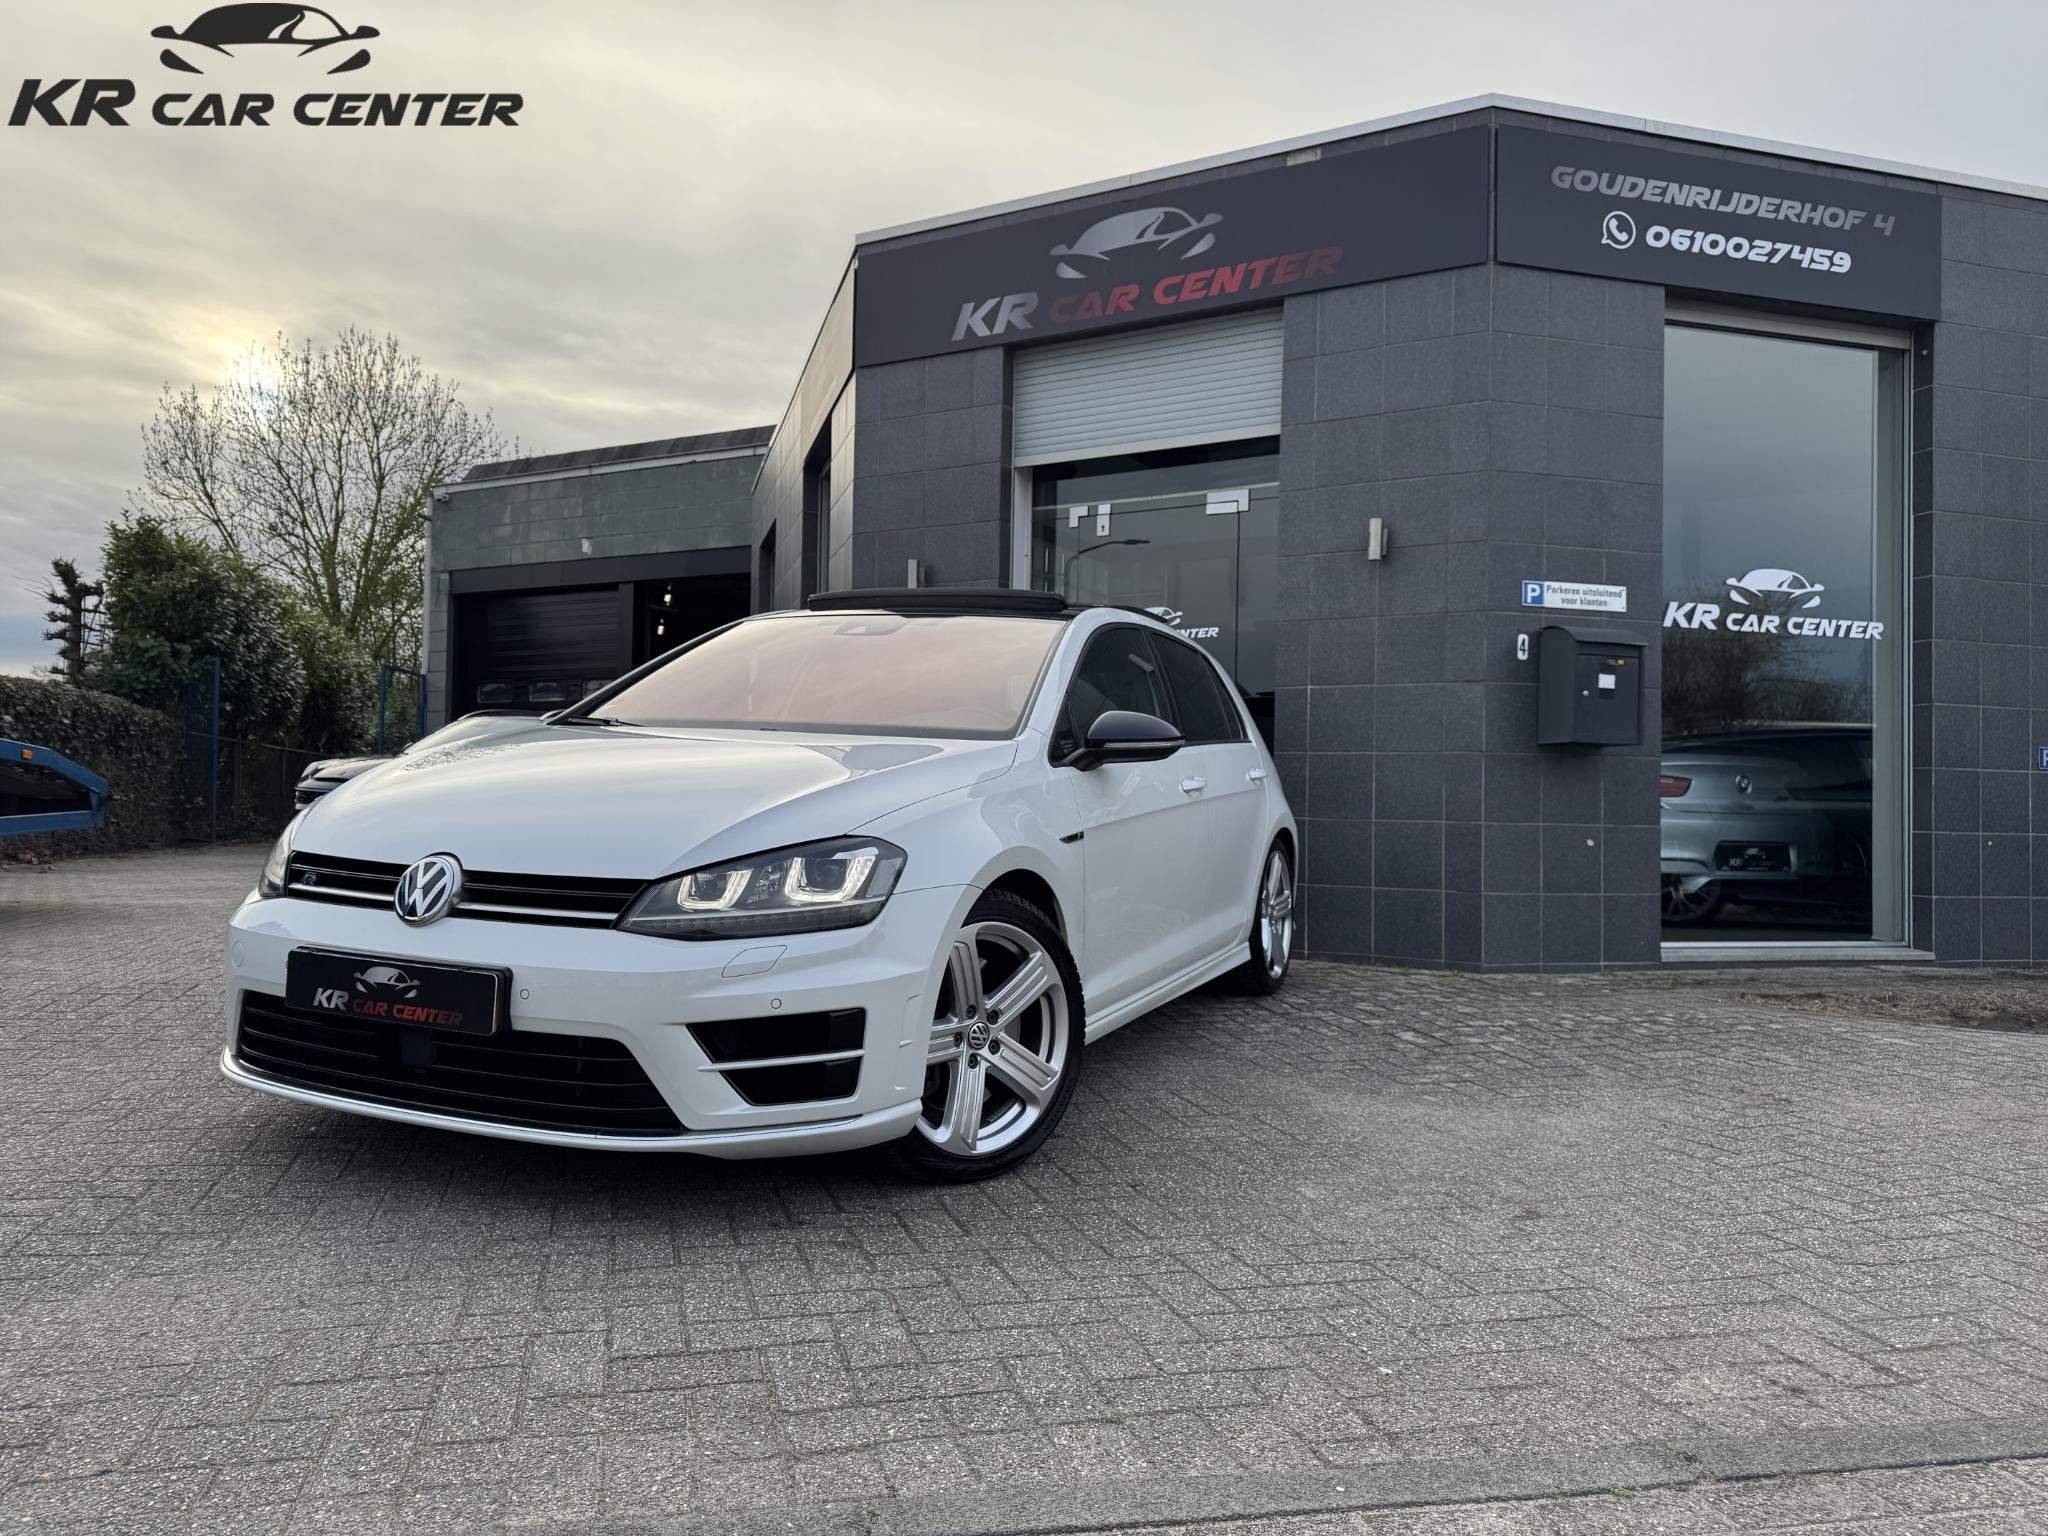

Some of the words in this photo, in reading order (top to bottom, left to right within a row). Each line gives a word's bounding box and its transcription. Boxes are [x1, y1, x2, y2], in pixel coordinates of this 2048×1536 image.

[1551, 165, 1867, 231] GOUDENRIJDERHOF
[1873, 216, 1896, 237] 4
[1646, 225, 1852, 274] 0610027459
[951, 291, 1039, 341] KR
[1048, 284, 1140, 323] CAR
[1153, 245, 1343, 305] CENTER
[1527, 584, 1540, 603] P
[1546, 584, 1581, 595] Parkeren
[1582, 587, 1622, 598] uitsluitend
[1560, 597, 1578, 605] voor
[1580, 596, 1608, 607] klanten
[1177, 626, 1219, 639] NTER
[1662, 601, 1721, 630] KR
[1726, 612, 1780, 634] CAR
[1786, 616, 1885, 640] CENTER
[1518, 637, 1527, 656] 4
[312, 987, 349, 1011] KR
[353, 999, 389, 1017] CAR
[392, 1004, 464, 1026] CENTER
